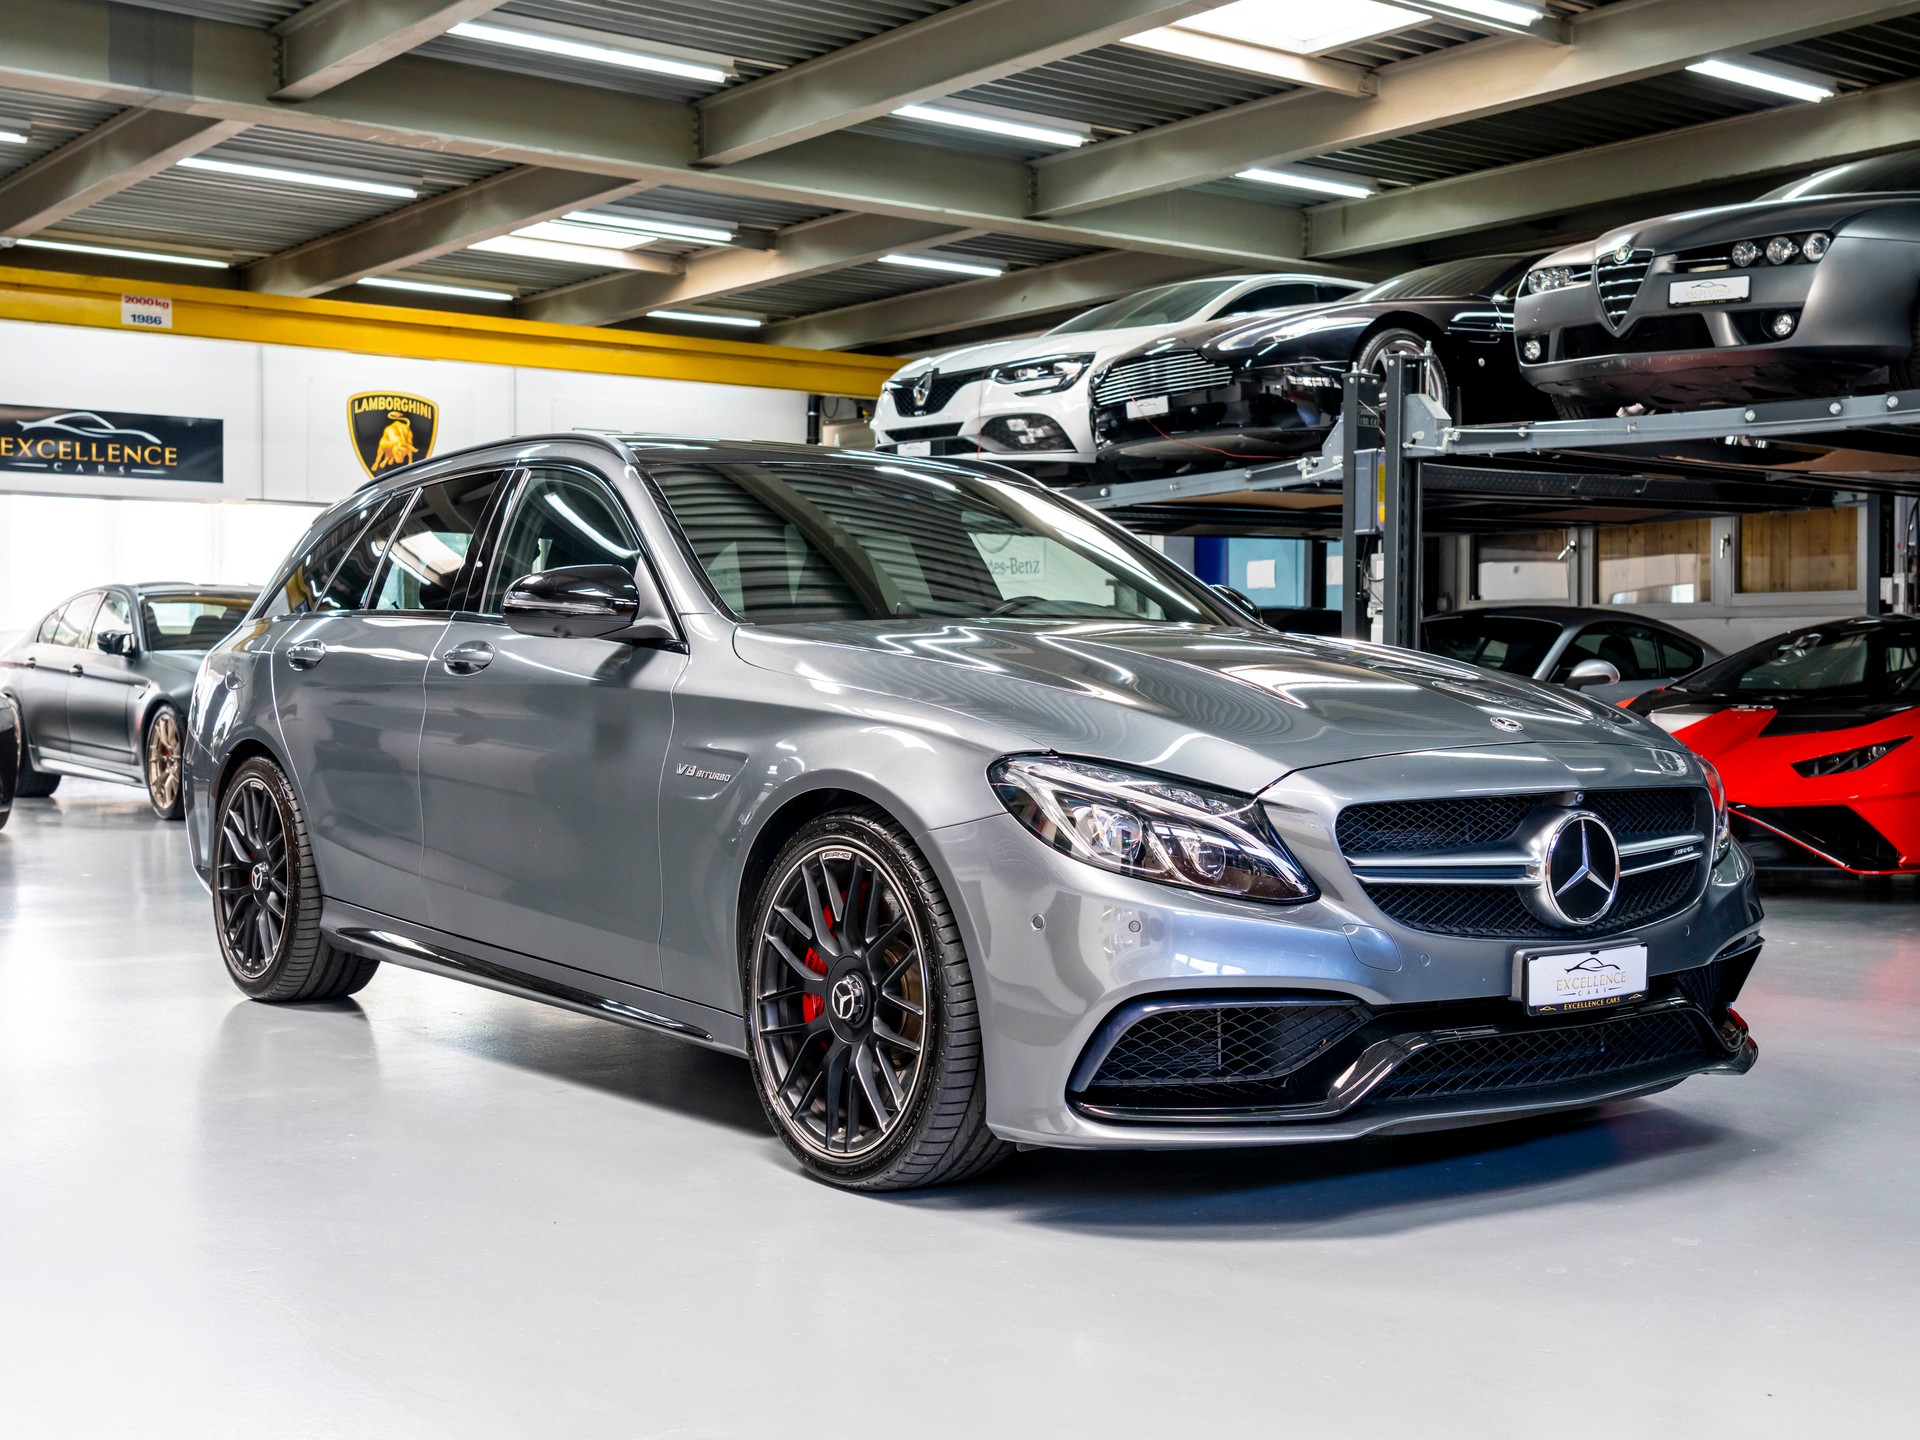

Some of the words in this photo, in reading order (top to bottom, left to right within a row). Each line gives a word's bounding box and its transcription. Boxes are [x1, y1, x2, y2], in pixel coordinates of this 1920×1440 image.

[130, 313, 162, 325] 1986
[354, 396, 432, 419] LAMBORGHINI
[0, 436, 178, 467] EXCELLENCE
[53, 462, 125, 475] CARS
[676, 762, 697, 777] V8
[696, 769, 732, 782] BITURBO
[1556, 971, 1627, 991] EXCELLENCE
[1577, 988, 1607, 996] CARS
[1563, 998, 1604, 1010] EXCELLENCE
[1605, 996, 1621, 1004] CARS
